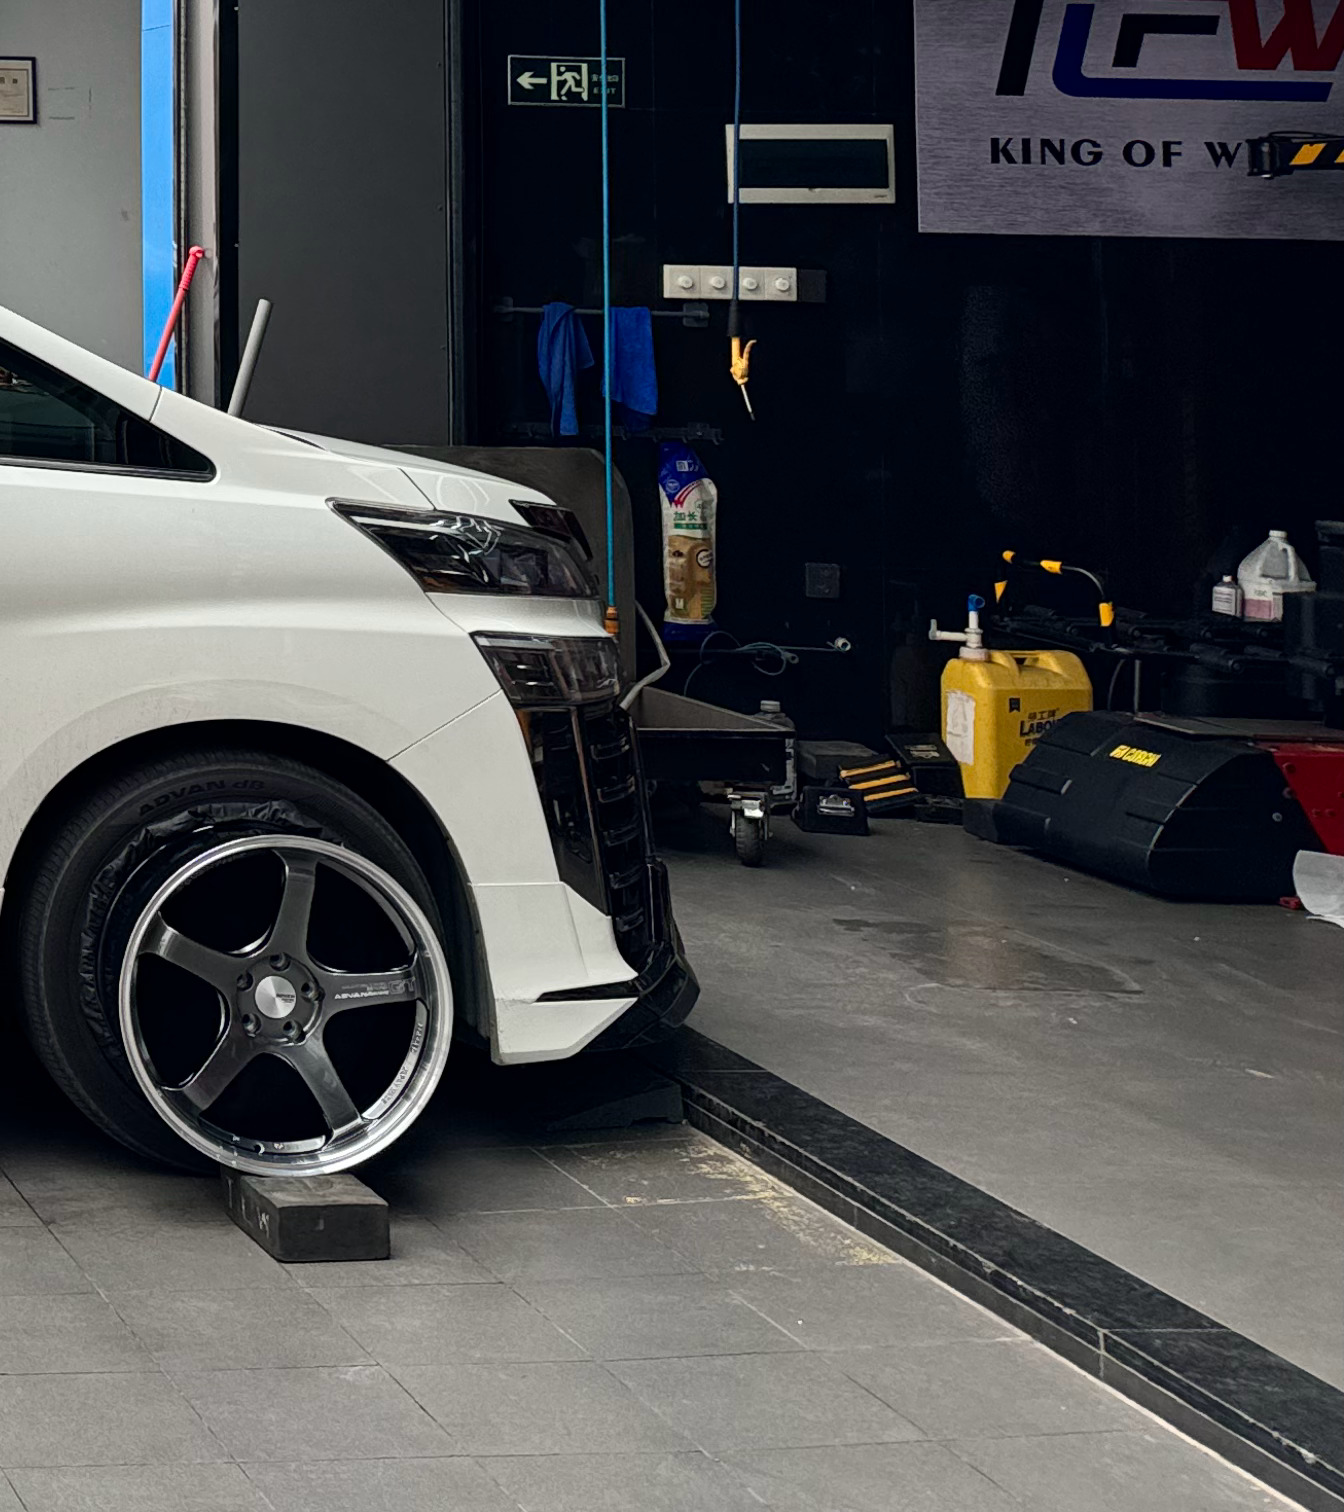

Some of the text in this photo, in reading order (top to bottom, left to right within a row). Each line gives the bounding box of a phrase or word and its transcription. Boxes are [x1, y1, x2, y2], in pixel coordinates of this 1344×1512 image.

[989, 136, 1103, 168] KING
[1122, 139, 1184, 170] OF
[139, 779, 265, 816] ADVAN dB
